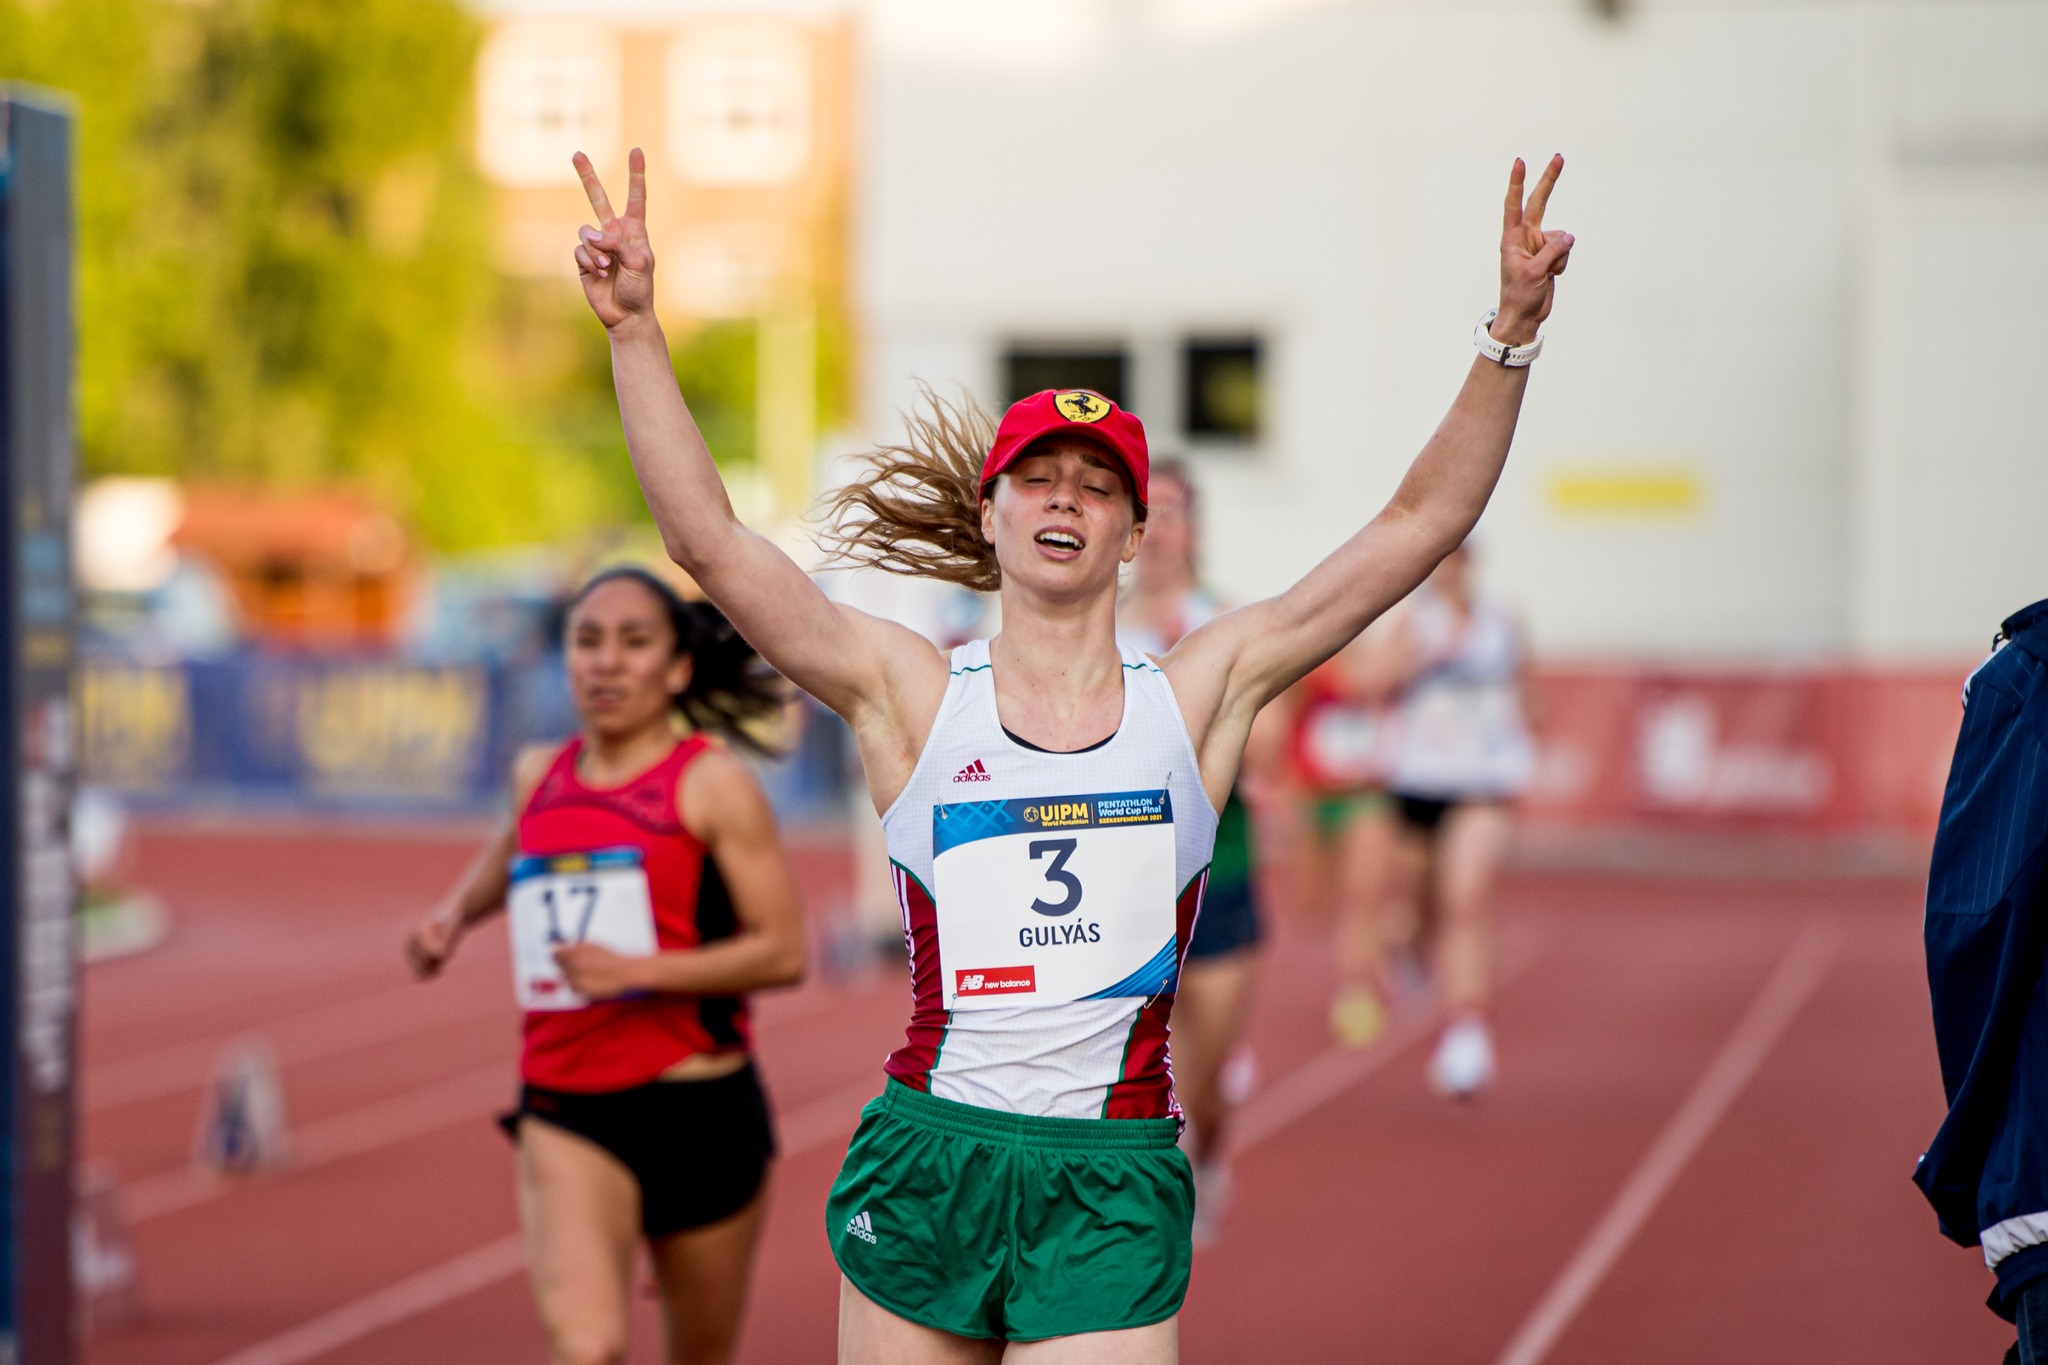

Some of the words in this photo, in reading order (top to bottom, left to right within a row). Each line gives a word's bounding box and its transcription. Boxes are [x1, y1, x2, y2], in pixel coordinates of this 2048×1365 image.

[953, 773, 991, 783] adidas
[1040, 803, 1089, 821] UIPM
[1098, 799, 1153, 808] PENTATHLON
[1098, 808, 1124, 817] World
[1125, 807, 1142, 816] Cup
[1143, 805, 1162, 814] Final
[1029, 838, 1083, 917] 3
[542, 884, 599, 945] 17
[1019, 918, 1101, 948] GULYÁS
[1000, 979, 1031, 988] balance
[846, 1223, 877, 1245] adidas
